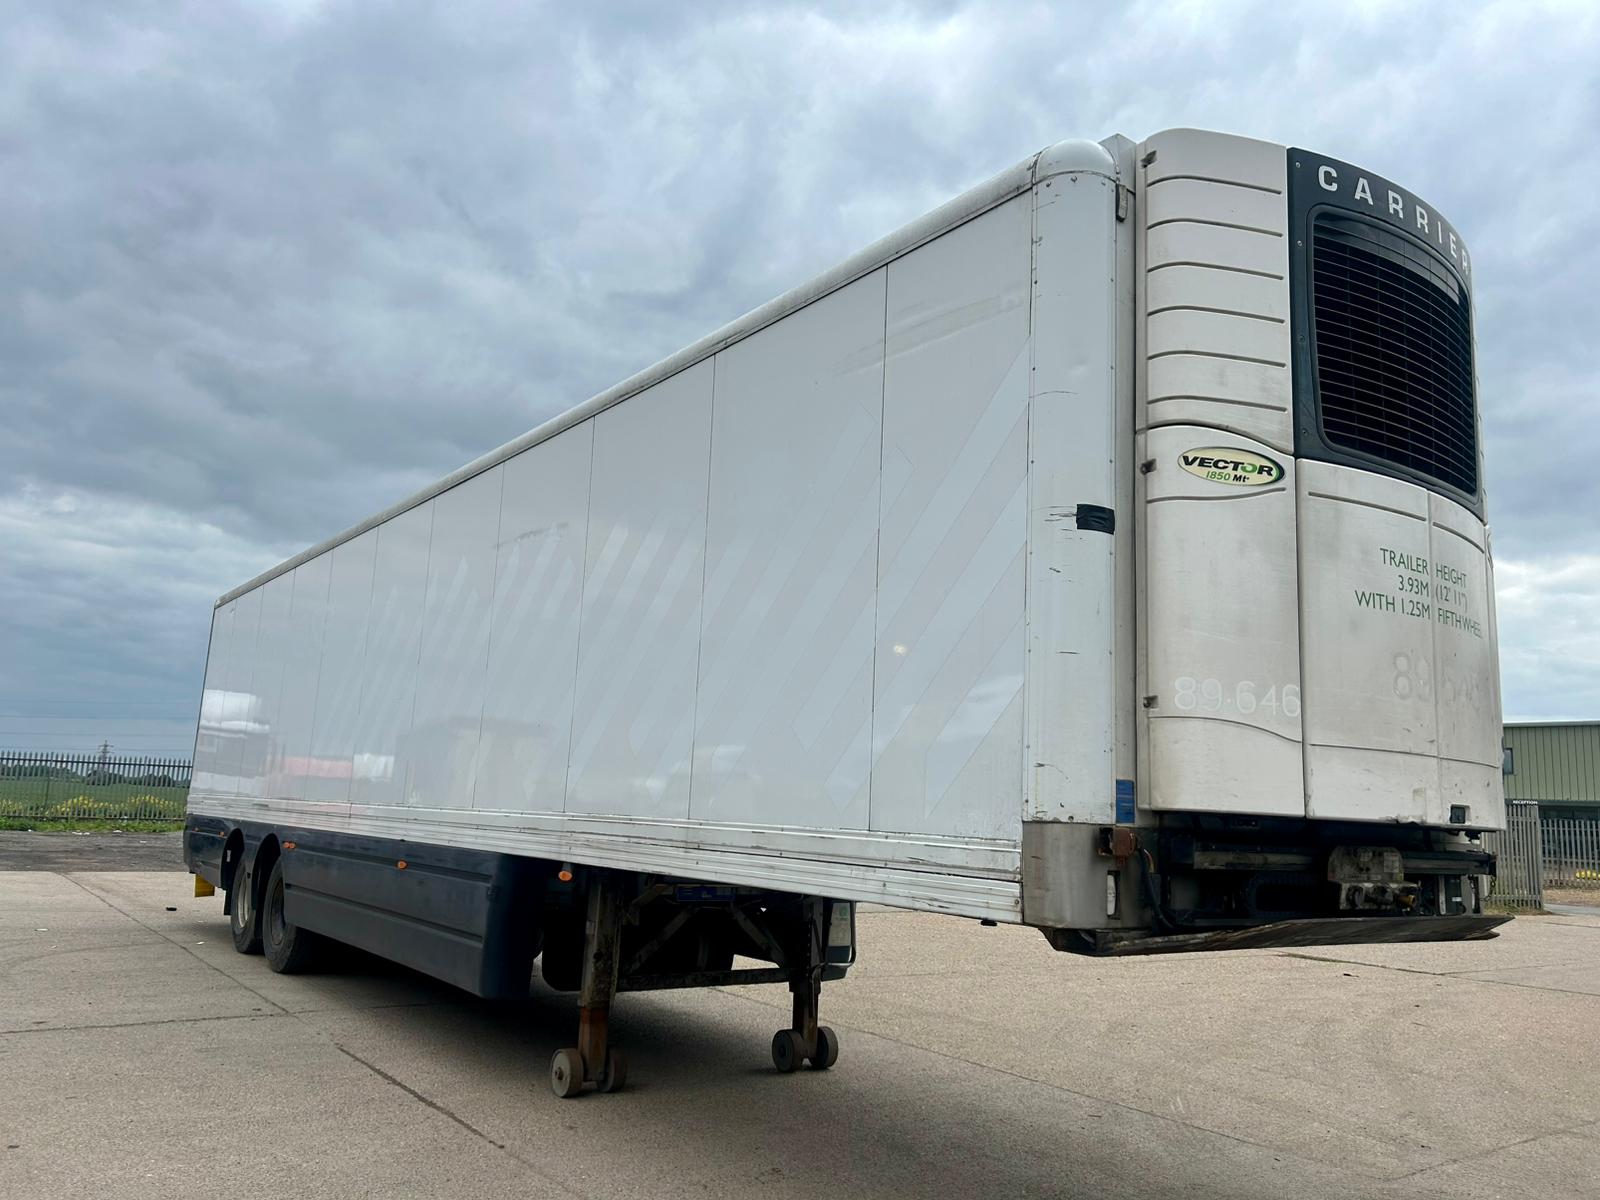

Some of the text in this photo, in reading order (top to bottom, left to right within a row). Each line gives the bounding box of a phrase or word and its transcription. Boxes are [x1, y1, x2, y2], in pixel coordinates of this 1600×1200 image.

[1318, 165, 1469, 275] CARRIER
[1182, 455, 1274, 477] VECTOR
[1206, 470, 1231, 481] 1850
[1380, 547, 1467, 589] TRAILER HEIGHT
[1398, 574, 1430, 598] 3.93M
[1354, 589, 1396, 613] WITH
[1401, 598, 1431, 620] 1.25M
